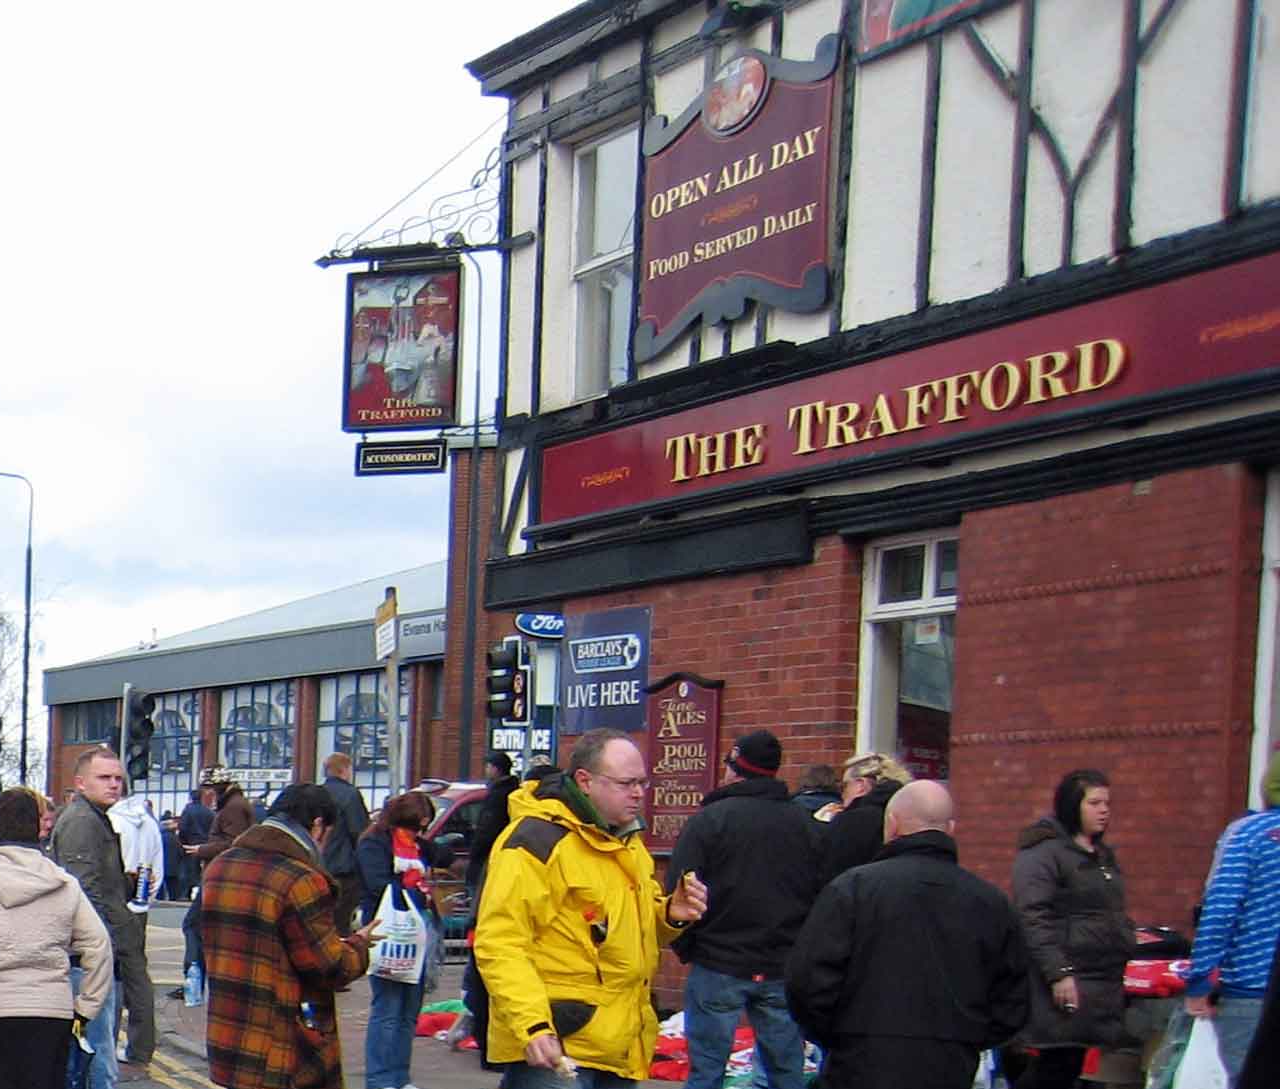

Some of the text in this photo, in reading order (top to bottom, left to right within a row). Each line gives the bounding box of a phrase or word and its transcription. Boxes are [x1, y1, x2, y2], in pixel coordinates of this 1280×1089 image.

[650, 126, 824, 219] OPEN ALL DAY
[648, 202, 818, 281] FOOD SERVED DAILY
[358, 408, 442, 421] TRAFFORD
[665, 337, 1125, 484] THE TRAFFORD
[531, 614, 565, 631] For
[577, 640, 623, 660] BARCLAYS
[567, 679, 641, 709] LIVE HERE
[657, 710, 707, 738] ALES
[664, 743, 707, 764] POOL
